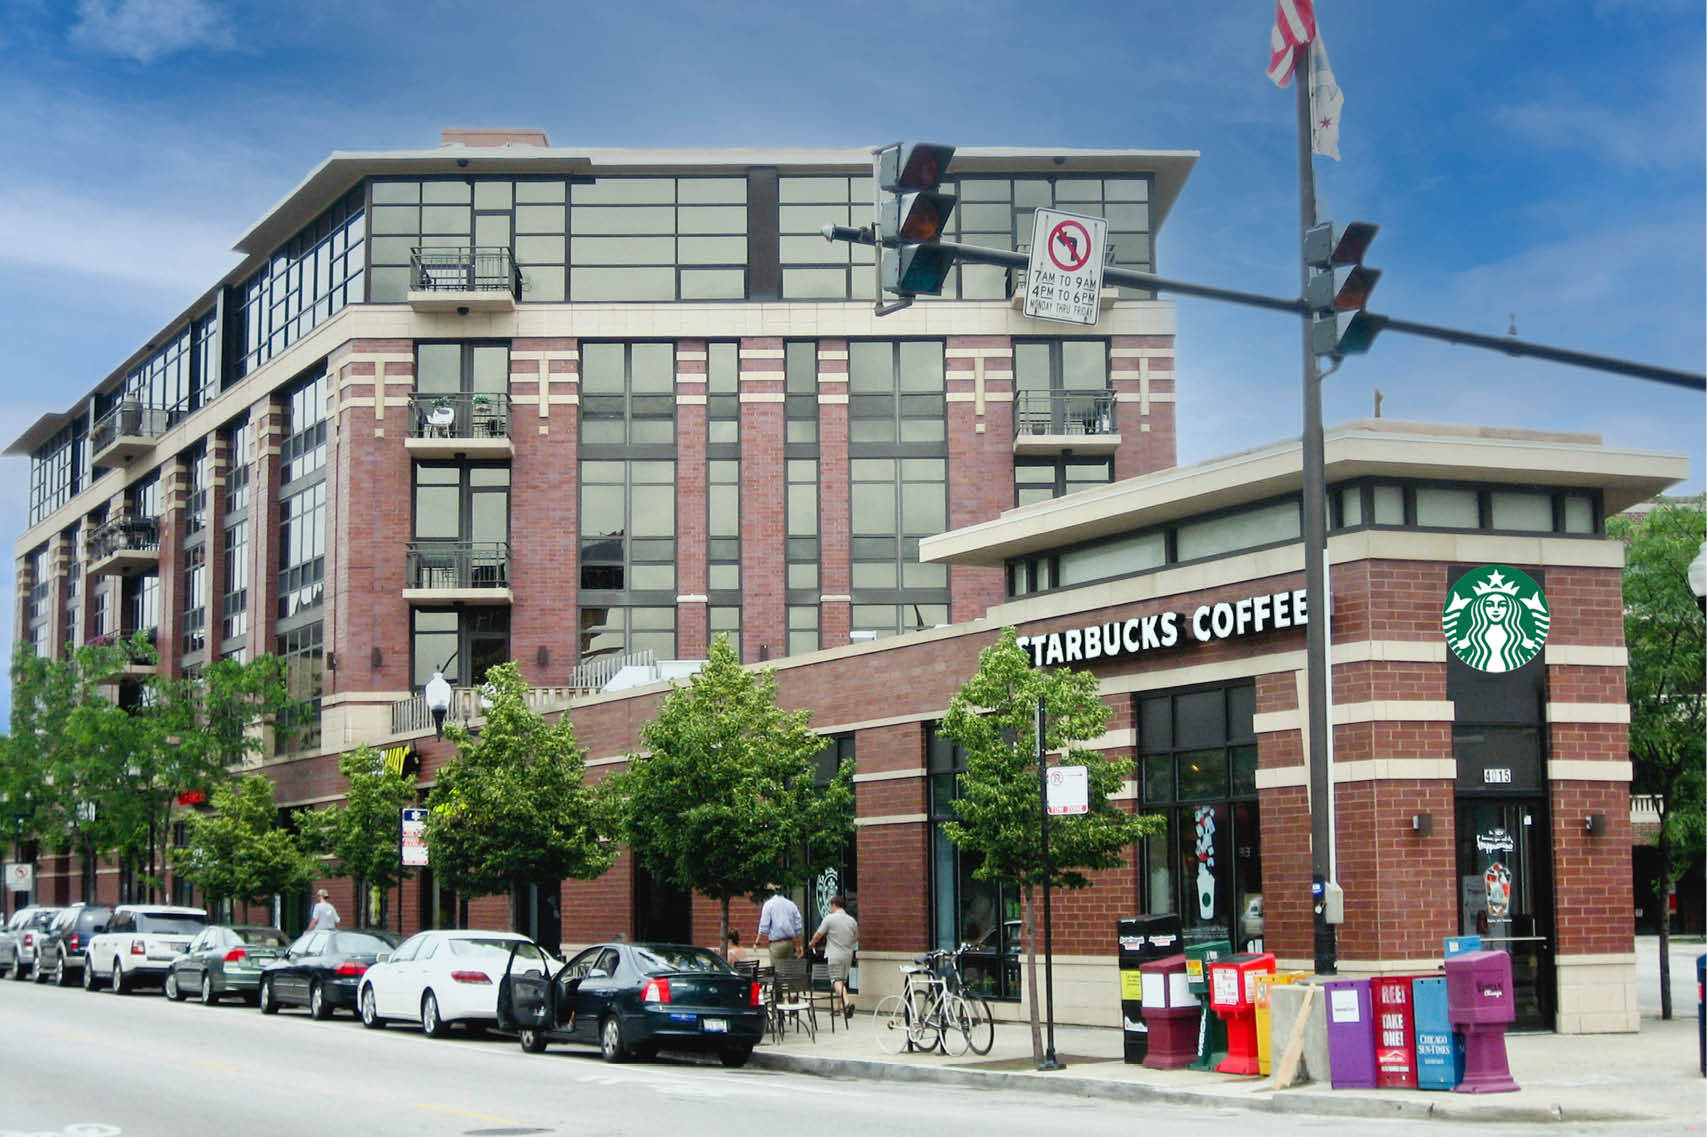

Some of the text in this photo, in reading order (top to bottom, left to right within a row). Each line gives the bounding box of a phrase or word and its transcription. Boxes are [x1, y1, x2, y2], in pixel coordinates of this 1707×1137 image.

[1034, 270, 1096, 289] 7AM TO 9AM
[1032, 285, 1095, 304] 4PM TO 6PM
[1030, 298, 1094, 317] MONDAY THRU FRIDAY
[1192, 589, 1308, 642] COFFEE
[1485, 769, 1510, 782] 4015
[1378, 985, 1406, 1004] REE!
[1382, 1030, 1404, 1047] ONE!
[1419, 1034, 1448, 1045] CHICAGO
[1418, 1044, 1450, 1056] SUN-TIMES
